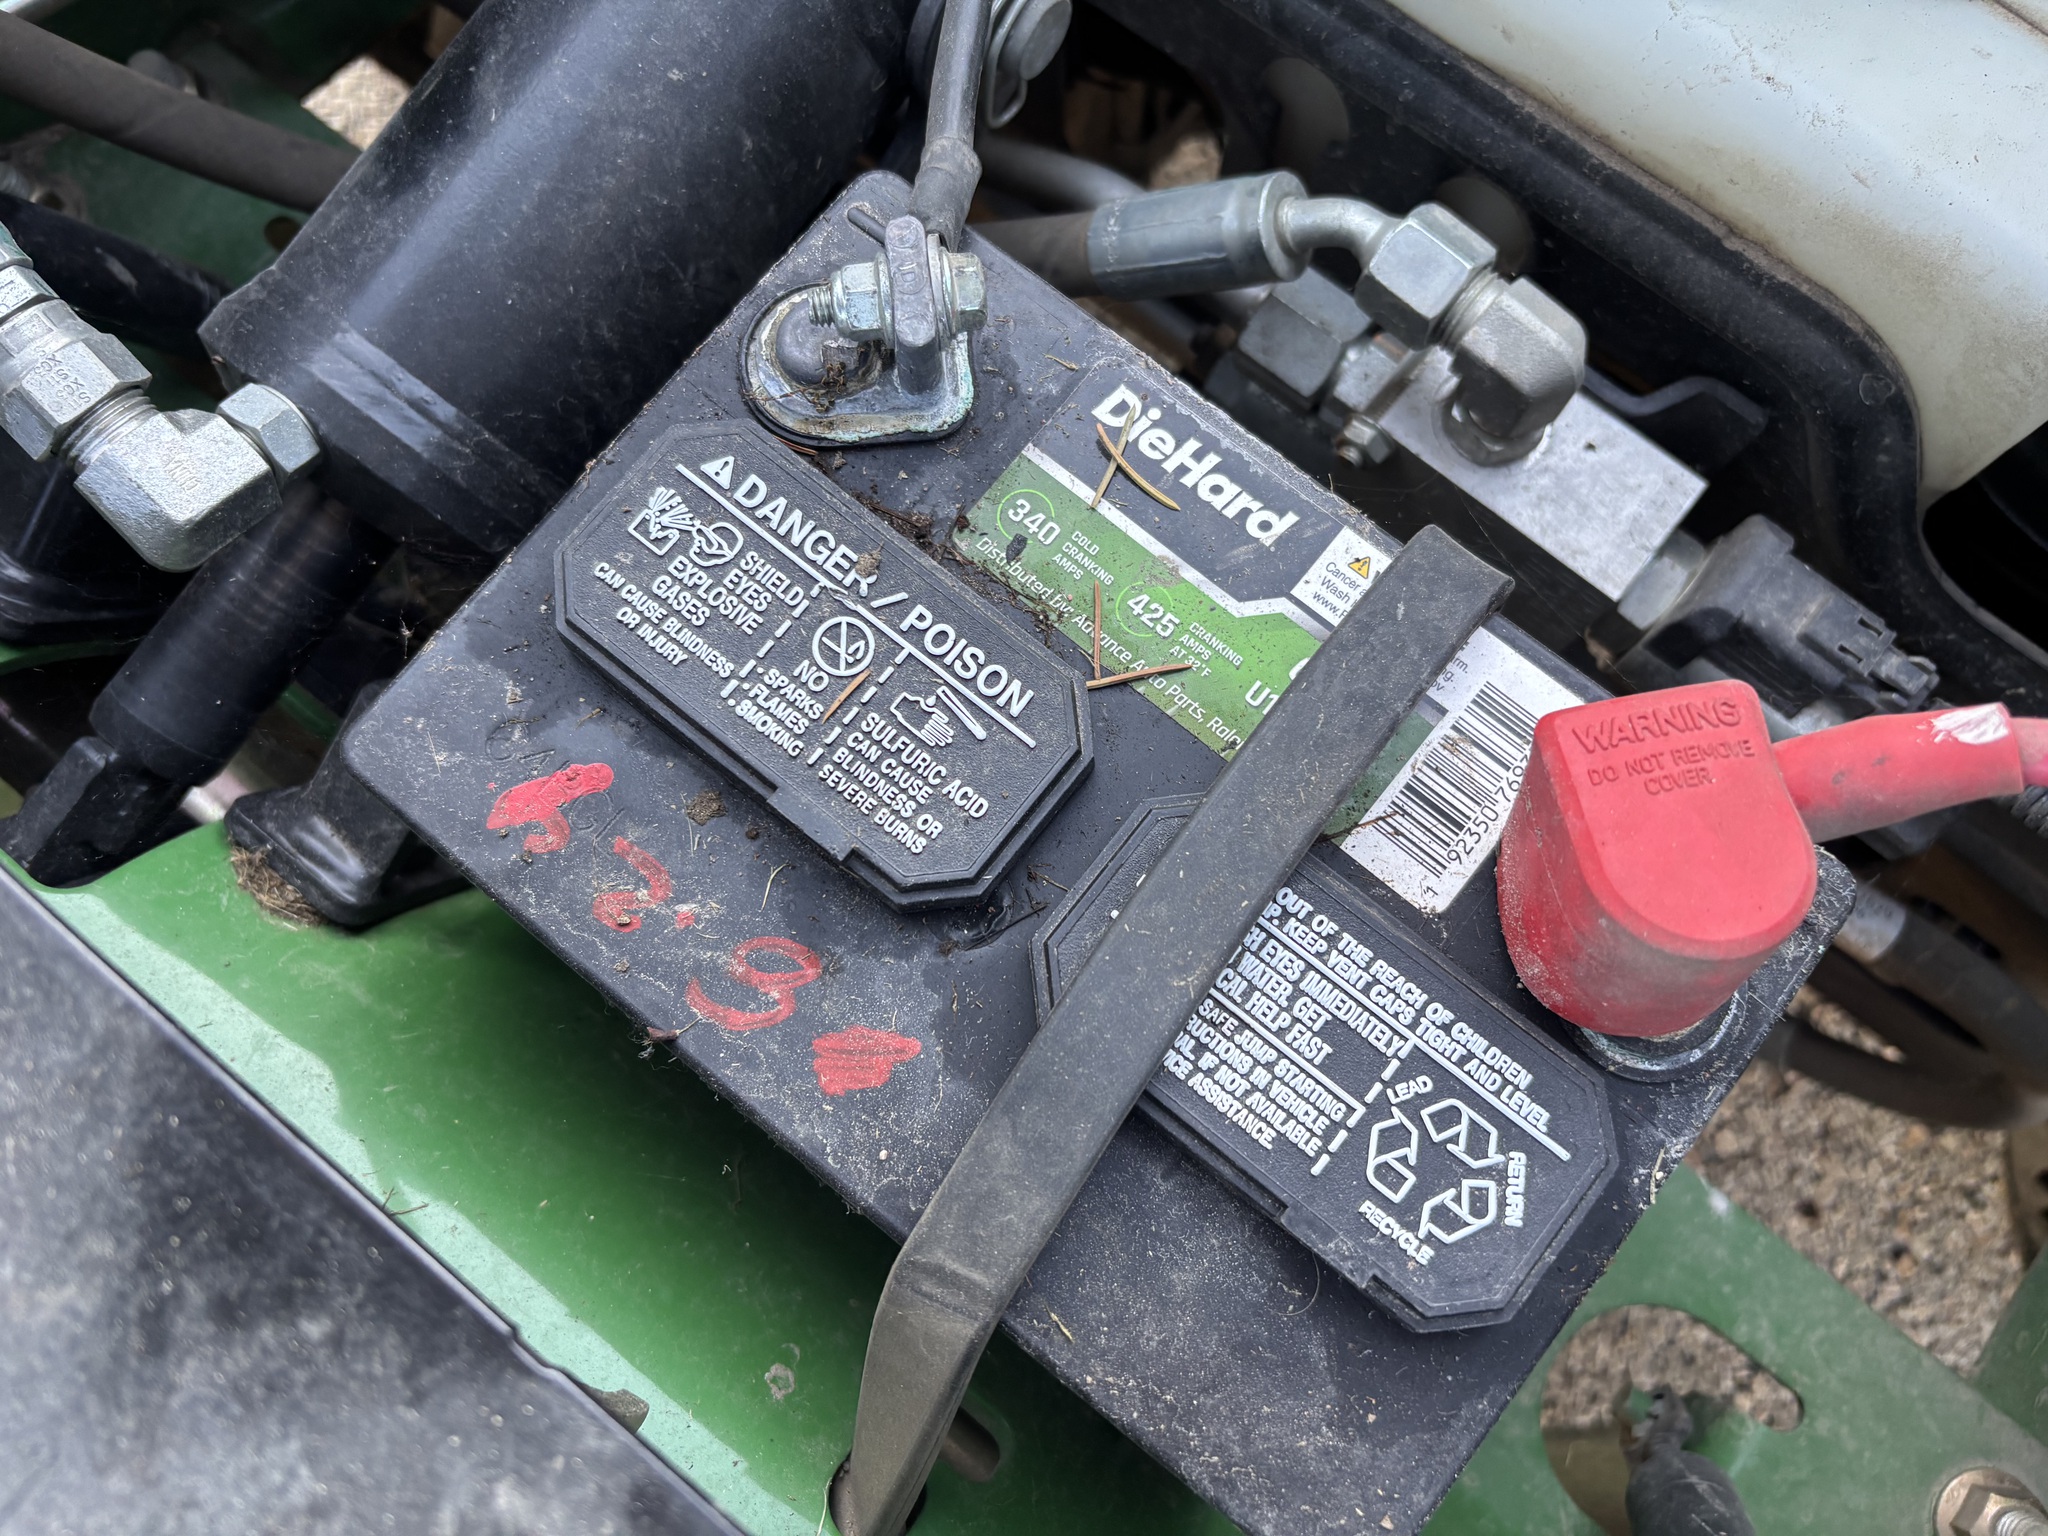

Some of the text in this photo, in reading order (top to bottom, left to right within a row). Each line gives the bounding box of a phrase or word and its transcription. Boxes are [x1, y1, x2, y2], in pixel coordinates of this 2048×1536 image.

[1091, 384, 1299, 546] DieHard
[1008, 499, 1060, 544] 340
[1069, 529, 1101, 557] COLD
[723, 568, 772, 611] EYES
[740, 551, 804, 612] SHIELD
[1051, 552, 1084, 581] AMPS
[1060, 540, 1115, 586] CRANKING
[1319, 575, 1352, 604] Wash
[1323, 560, 1361, 592] Cancer
[592, 562, 734, 677] CAN CAUSE BLINDNESS
[652, 575, 710, 625] GASES
[667, 555, 763, 634] EXPLOSIVE
[733, 474, 877, 596] DANGER
[900, 604, 1034, 717] POISON
[1127, 594, 1180, 636] 425
[616, 607, 688, 665] OR INJURY
[1168, 644, 1186, 660] AT
[1177, 632, 1212, 661] AMPS
[1186, 621, 1244, 667] CRANKING
[764, 666, 824, 719] SPARKS
[793, 660, 829, 691] NO
[1165, 684, 1208, 722] Parts,
[735, 699, 804, 756] SMOKING
[748, 683, 809, 734] FLAMES
[1571, 694, 1743, 754] WARNING
[847, 732, 933, 804] CAN CAUSE
[861, 711, 988, 817] SULFURIC ACID
[1586, 736, 1755, 787] DO NOT REMOVE
[818, 764, 927, 853] SEVERE BURNS
[832, 747, 943, 838] BLINDNESS OR
[1444, 803, 1500, 867] 92350
[1237, 952, 1293, 1007] WATER.
[1293, 997, 1332, 1031] GET
[1259, 939, 1305, 981] EYES
[1299, 971, 1408, 1062] IMMEDIATELY
[1276, 887, 1533, 1090] OUT OF THE REACH OF CHILDREN
[1245, 991, 1291, 1031] HELP
[1285, 1023, 1333, 1065] FAST
[1283, 917, 1328, 954] KEEP
[1324, 950, 1373, 990] VENT
[1369, 985, 1415, 1025] CAPS
[1416, 1017, 1467, 1068] TIGHT
[1463, 1058, 1502, 1091] AND
[1500, 1085, 1550, 1132] LEVEL
[1199, 999, 1346, 1122] SAFE JUMP STARTING
[1387, 1076, 1433, 1104] LEAD
[1188, 1072, 1277, 1149] ASSISTANCE.
[1198, 1052, 1219, 1070] IF
[1214, 1065, 1251, 1097] NOT
[1245, 1092, 1322, 1157] AVAILABLE
[1249, 1066, 1272, 1089] IN
[1267, 1080, 1330, 1135] VEHICLE
[1504, 1152, 1526, 1226] RETURN
[1359, 1200, 1434, 1265] RECYCLE
